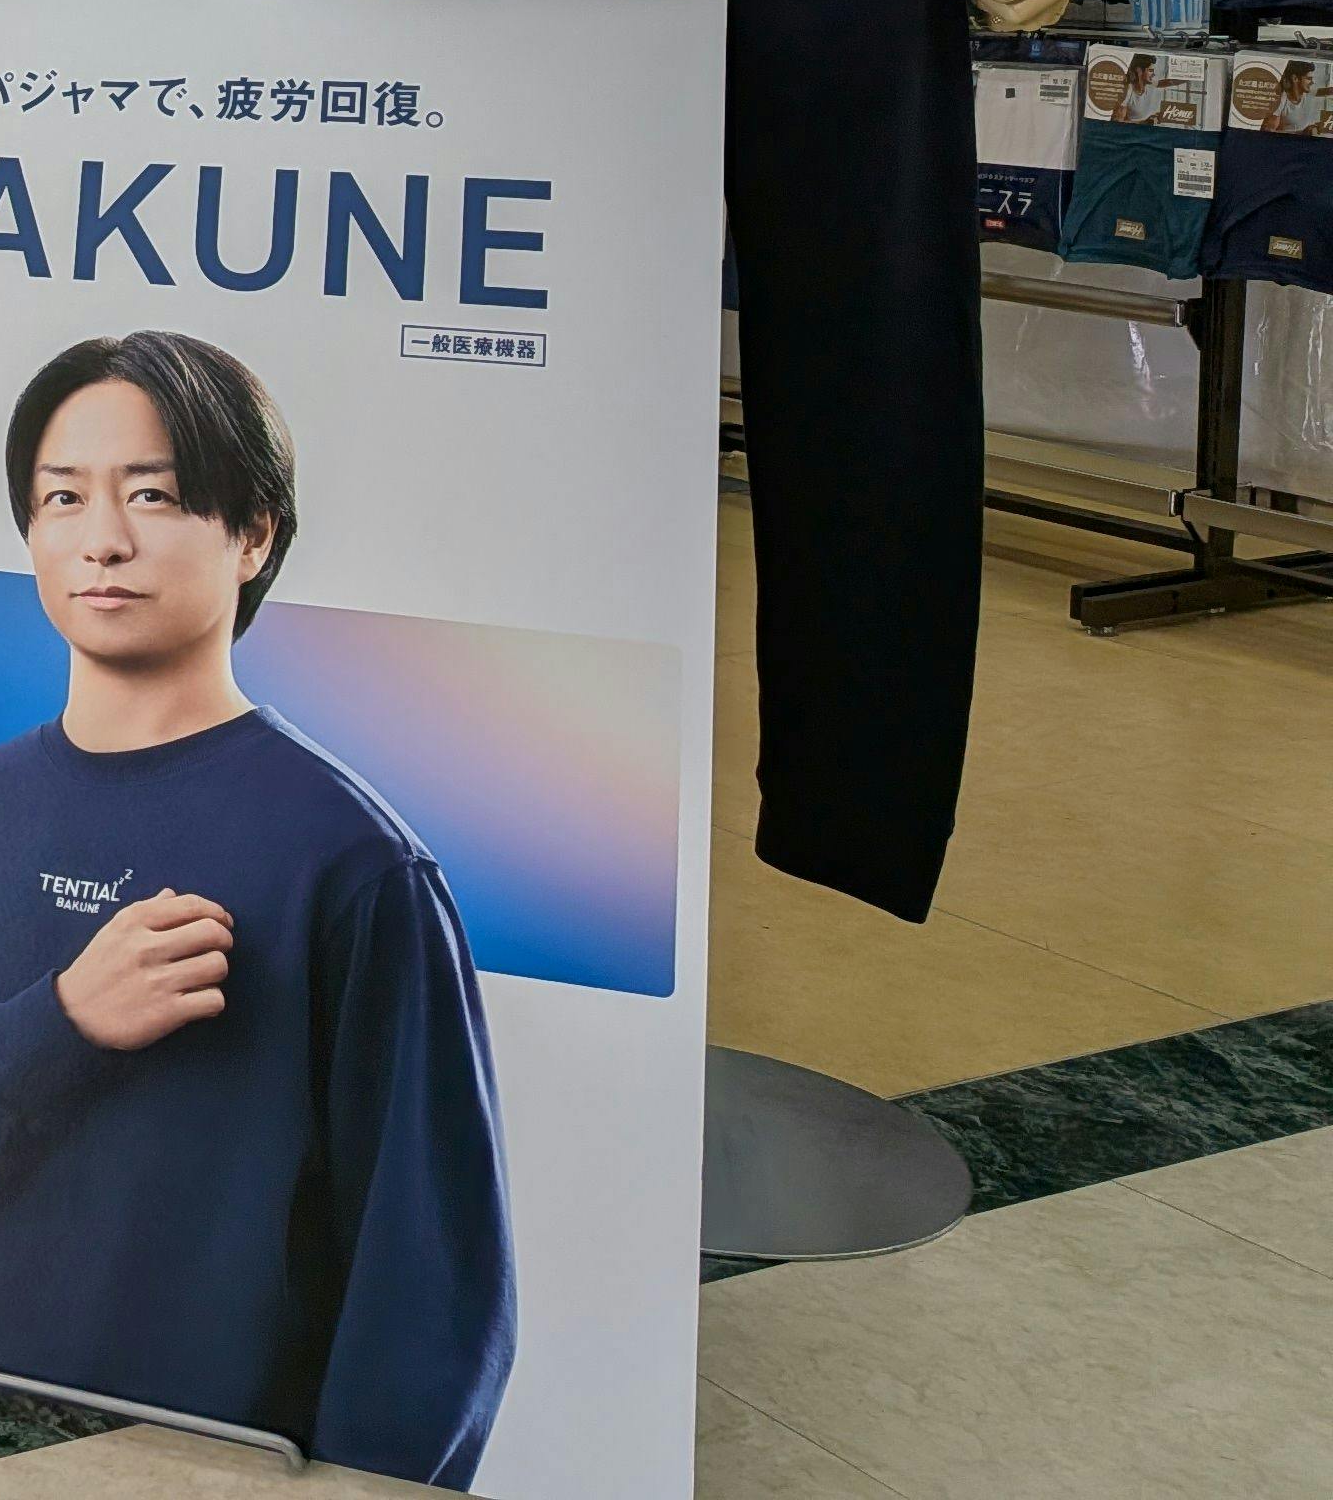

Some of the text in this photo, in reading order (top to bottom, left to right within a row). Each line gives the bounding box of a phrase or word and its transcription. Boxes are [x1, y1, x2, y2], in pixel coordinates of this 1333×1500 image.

[409, 331, 538, 362] 一般医療機器
[39, 873, 120, 902] TENTIAL
[56, 897, 101, 913] BAKUNE
